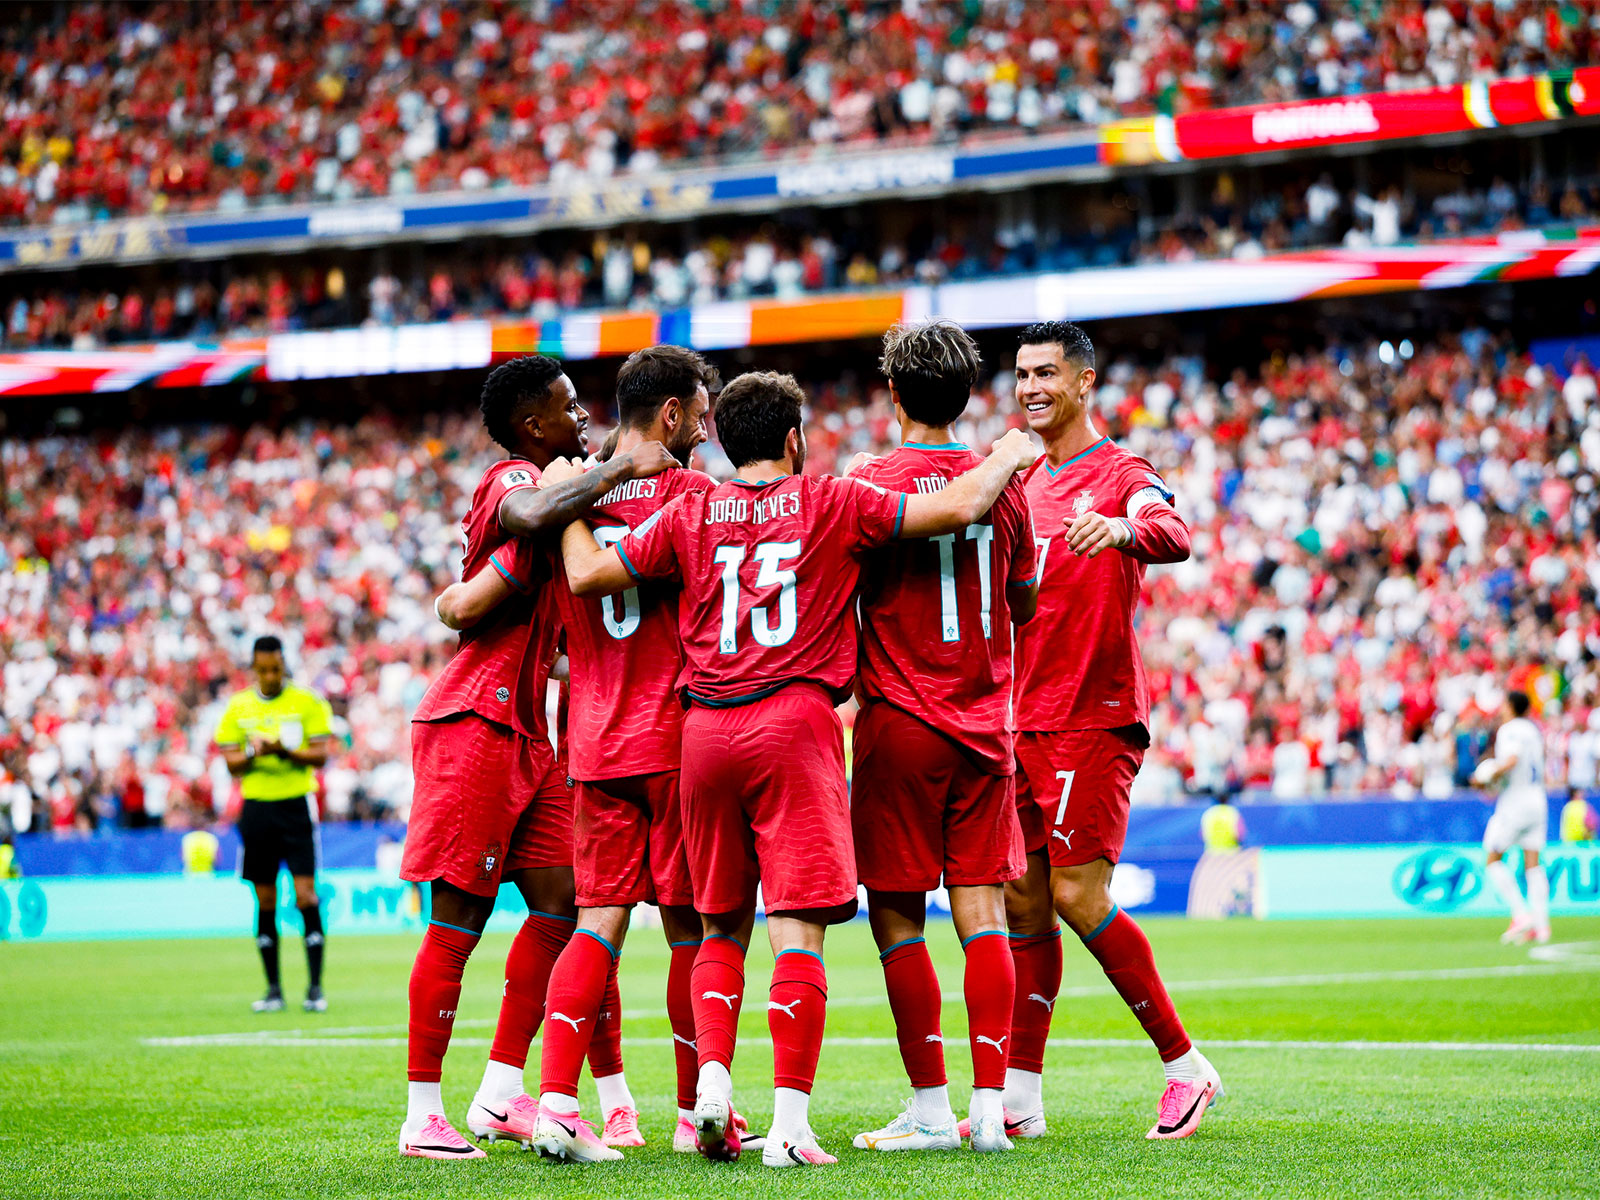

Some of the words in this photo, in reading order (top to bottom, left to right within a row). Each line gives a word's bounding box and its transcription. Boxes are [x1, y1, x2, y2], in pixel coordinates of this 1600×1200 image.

[705, 496, 747, 525] JOÃO
[752, 491, 800, 525] NEVES
[713, 538, 802, 654] 15
[928, 523, 995, 642] 11
[1054, 770, 1076, 826] 7
